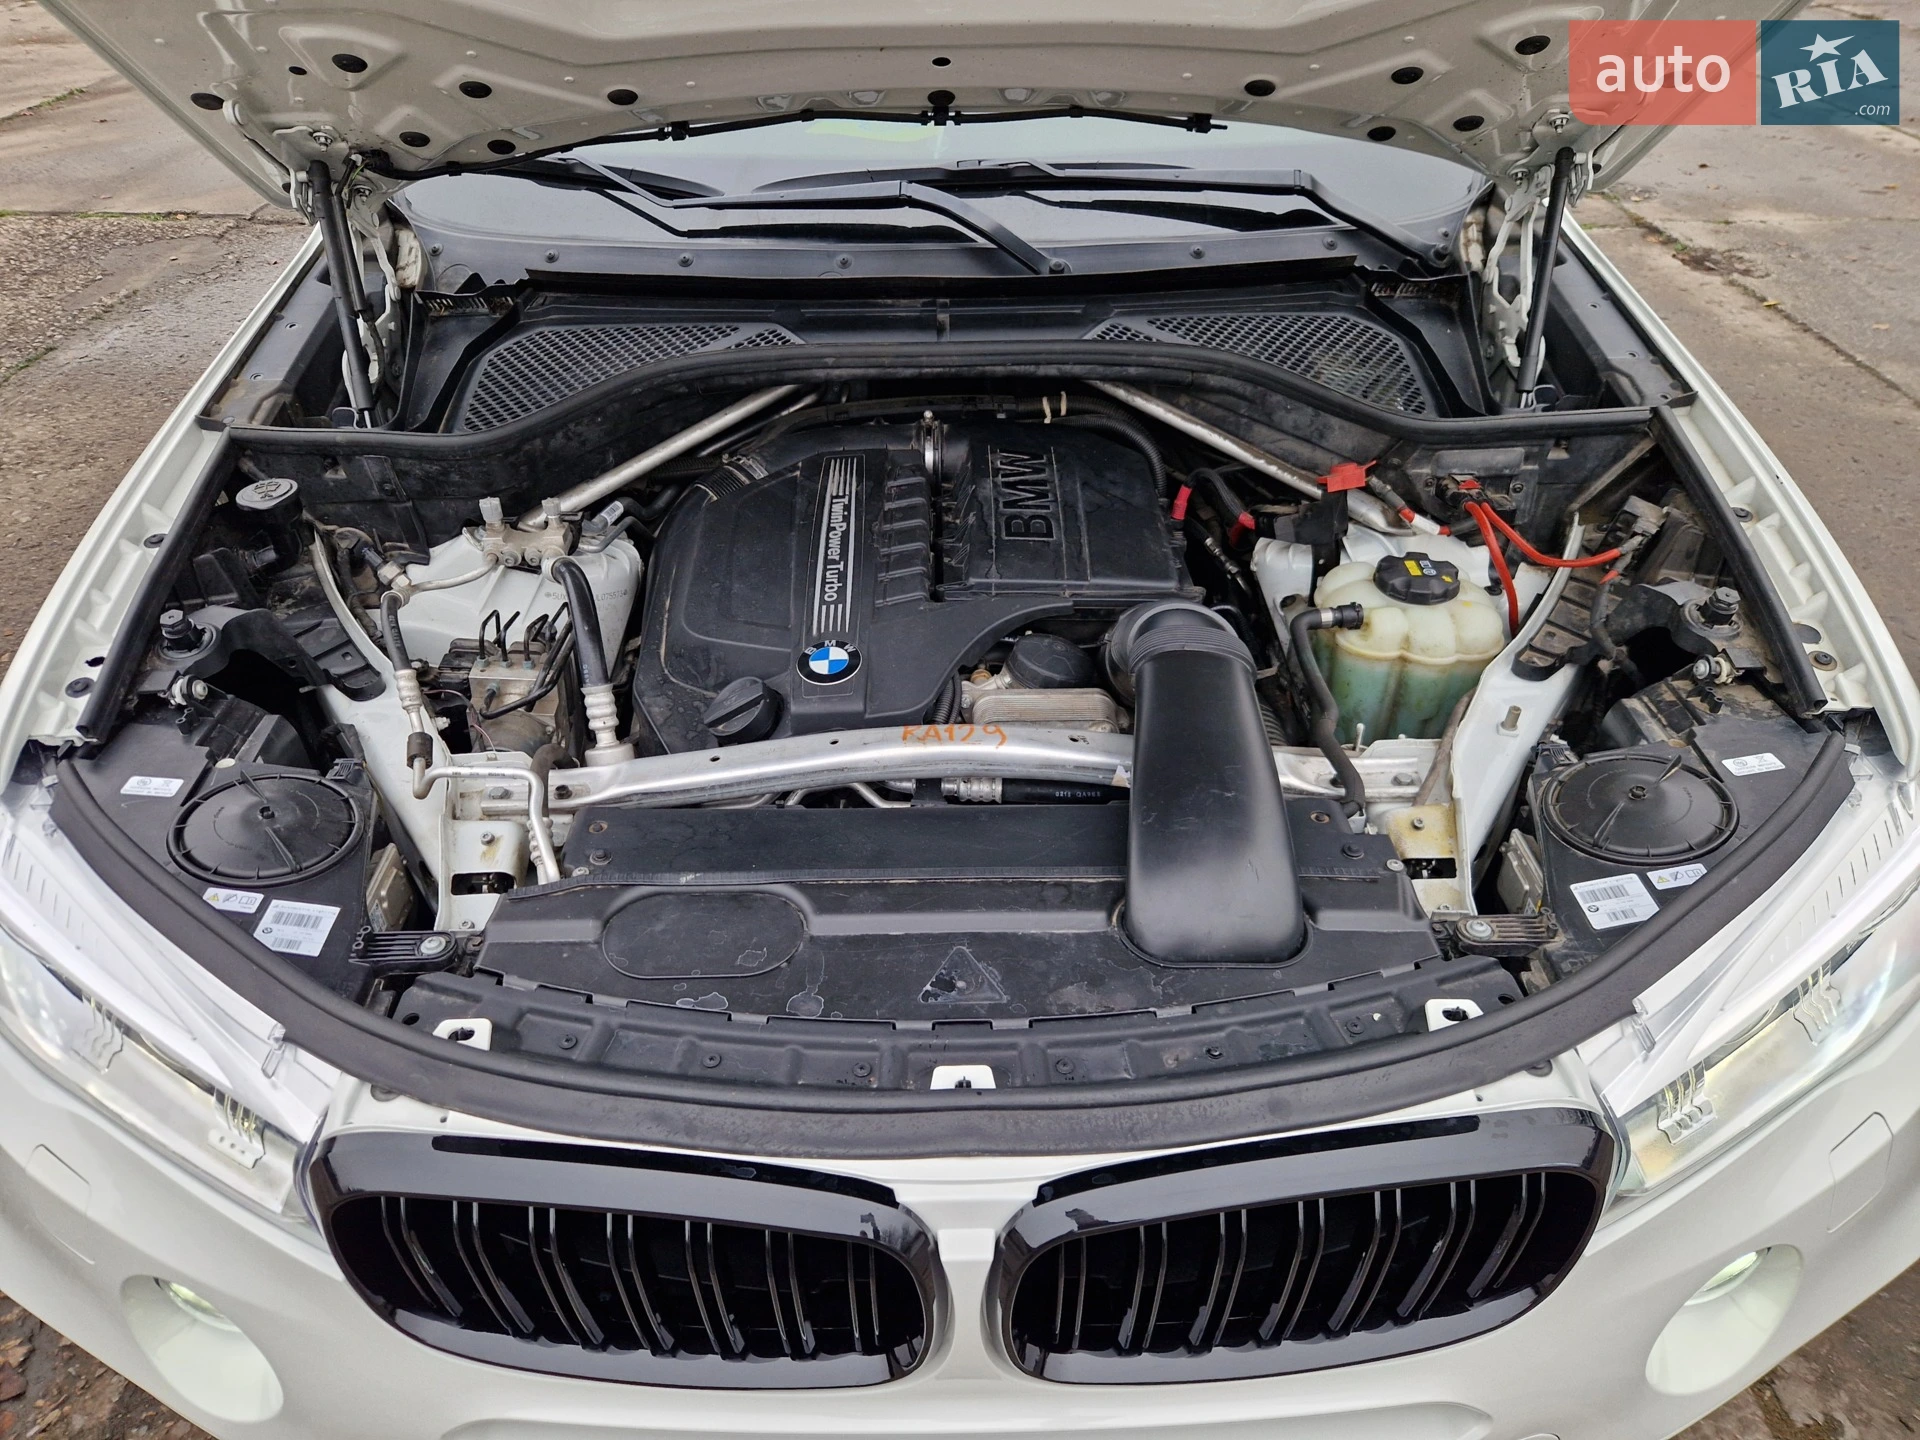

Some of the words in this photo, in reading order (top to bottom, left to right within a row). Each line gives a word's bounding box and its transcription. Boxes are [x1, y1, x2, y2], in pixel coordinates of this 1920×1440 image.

[998, 448, 1056, 540] BMW
[826, 495, 850, 561] TwinPower
[823, 560, 845, 602] Turbo
[804, 639, 857, 656] BMW
